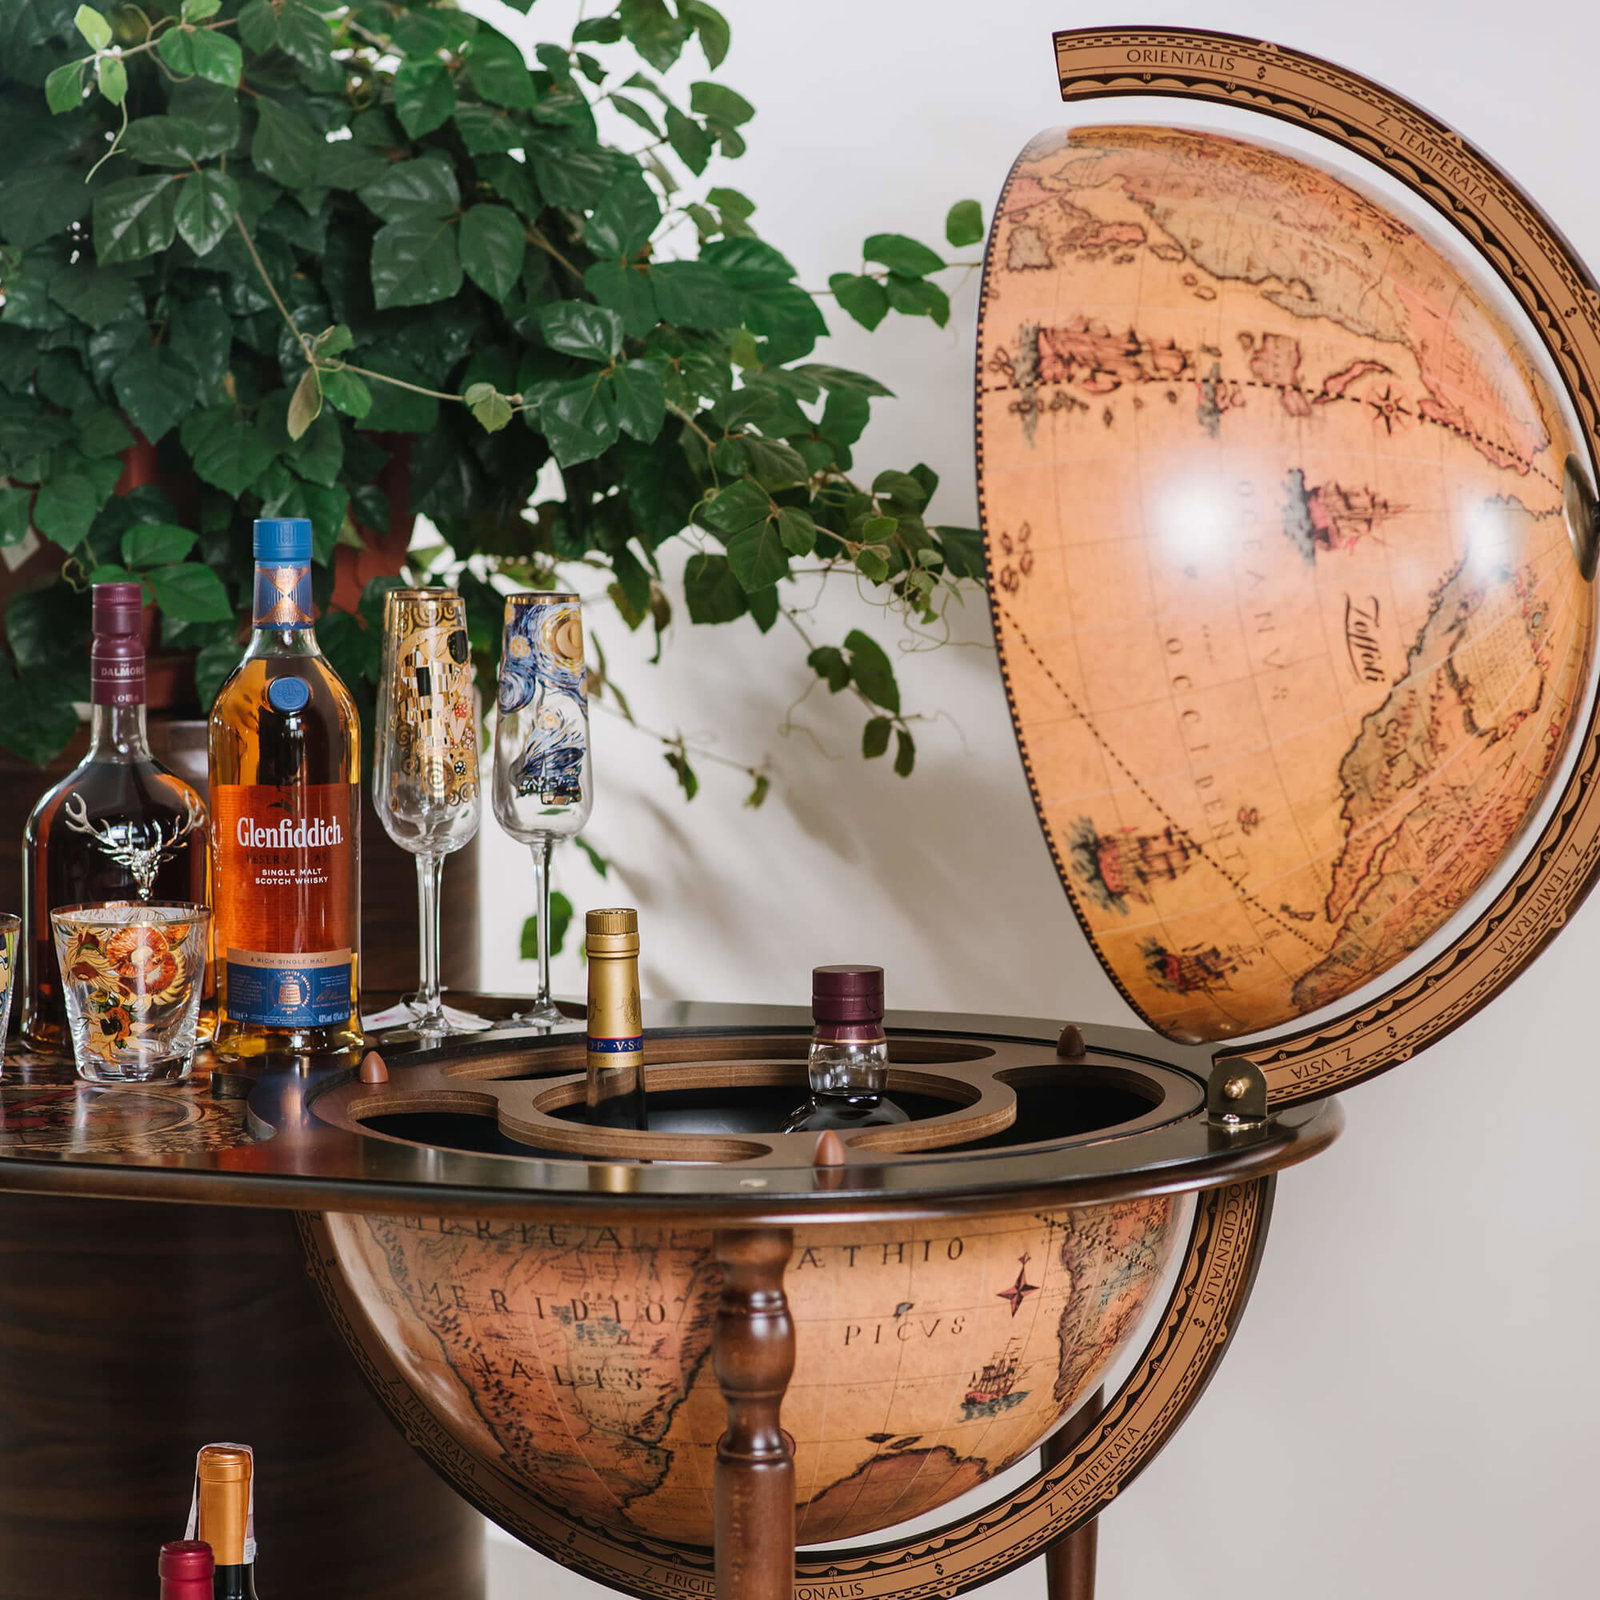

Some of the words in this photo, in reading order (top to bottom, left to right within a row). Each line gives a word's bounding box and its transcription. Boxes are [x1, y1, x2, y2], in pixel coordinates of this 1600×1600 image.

[1126, 49, 1236, 72] ORIENTALIS
[1375, 115, 1390, 133] Z.
[1398, 127, 1488, 207] TEMPERATA
[236, 815, 342, 849] Glenfiddich
[255, 878, 291, 886] SCOTCH
[294, 876, 329, 886] WHISKY
[261, 868, 296, 877] SINGLE
[299, 867, 322, 876] MALT
[1493, 866, 1571, 956] TEMPERATA
[1290, 1058, 1333, 1080] VSTA
[1202, 1183, 1242, 1307] OCCIDENTALIS
[844, 1315, 966, 1347] PICVS
[403, 1395, 477, 1475] TEMPERATA
[1045, 1503, 1064, 1517] Z.
[1061, 1426, 1141, 1502] TEMPERATA
[665, 1571, 717, 1595] FRIGID
